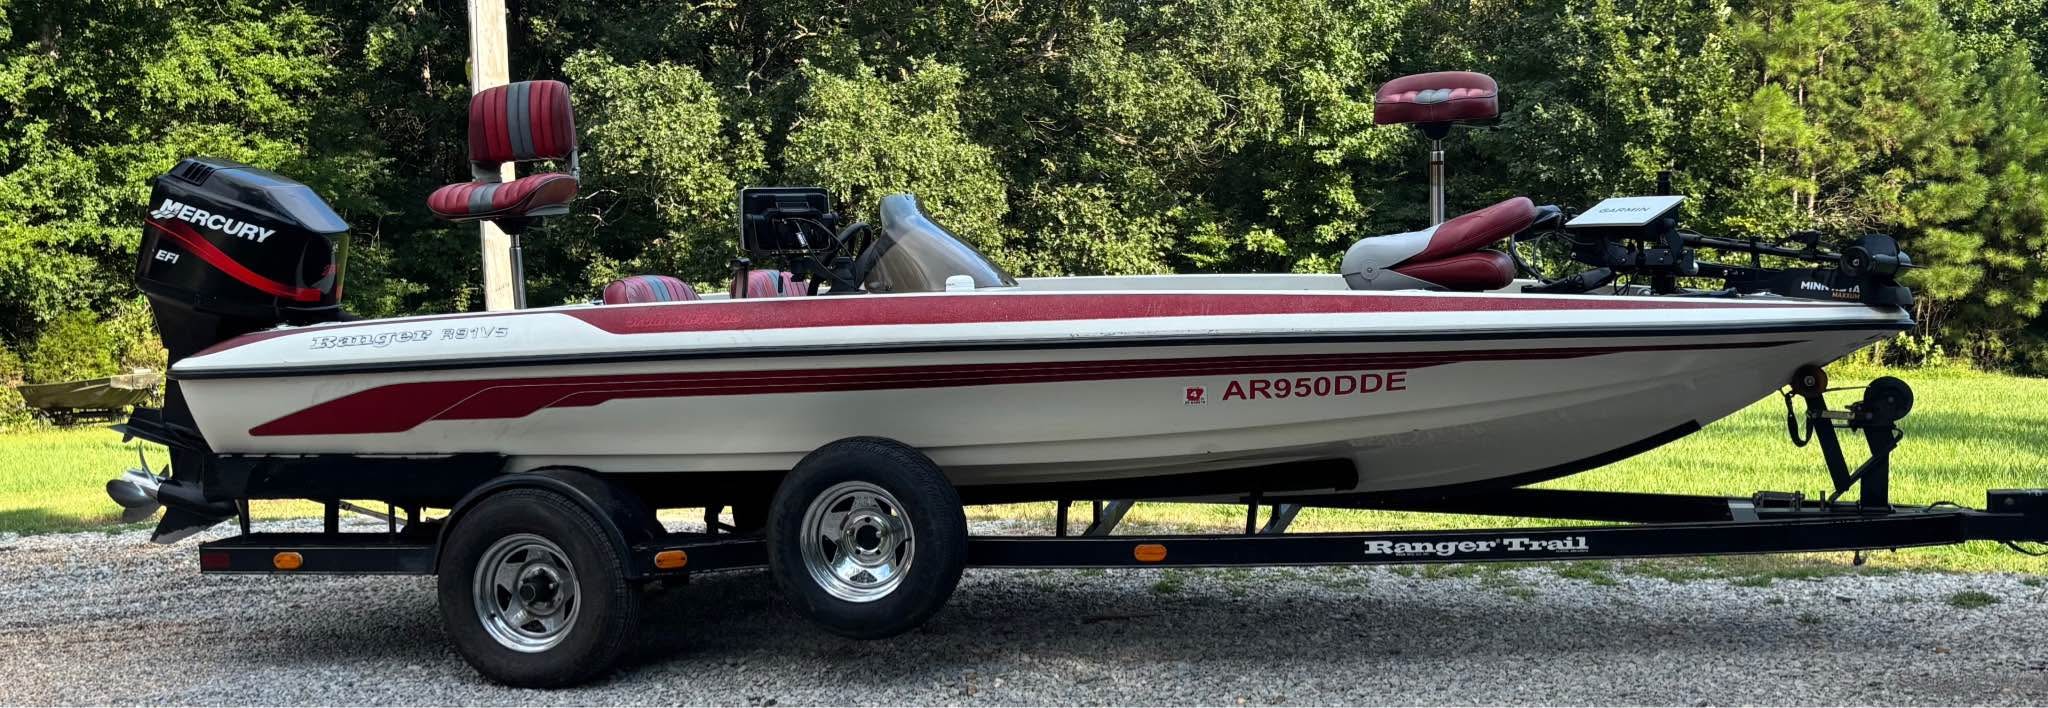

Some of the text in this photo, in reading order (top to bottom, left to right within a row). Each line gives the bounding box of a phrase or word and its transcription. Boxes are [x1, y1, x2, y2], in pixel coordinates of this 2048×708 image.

[156, 198, 276, 243] MERCURY
[155, 249, 180, 264] EFI
[308, 328, 432, 350] Ranger
[1222, 371, 1408, 400] AR950DDE
[1364, 536, 1590, 557] Ranger Trail
